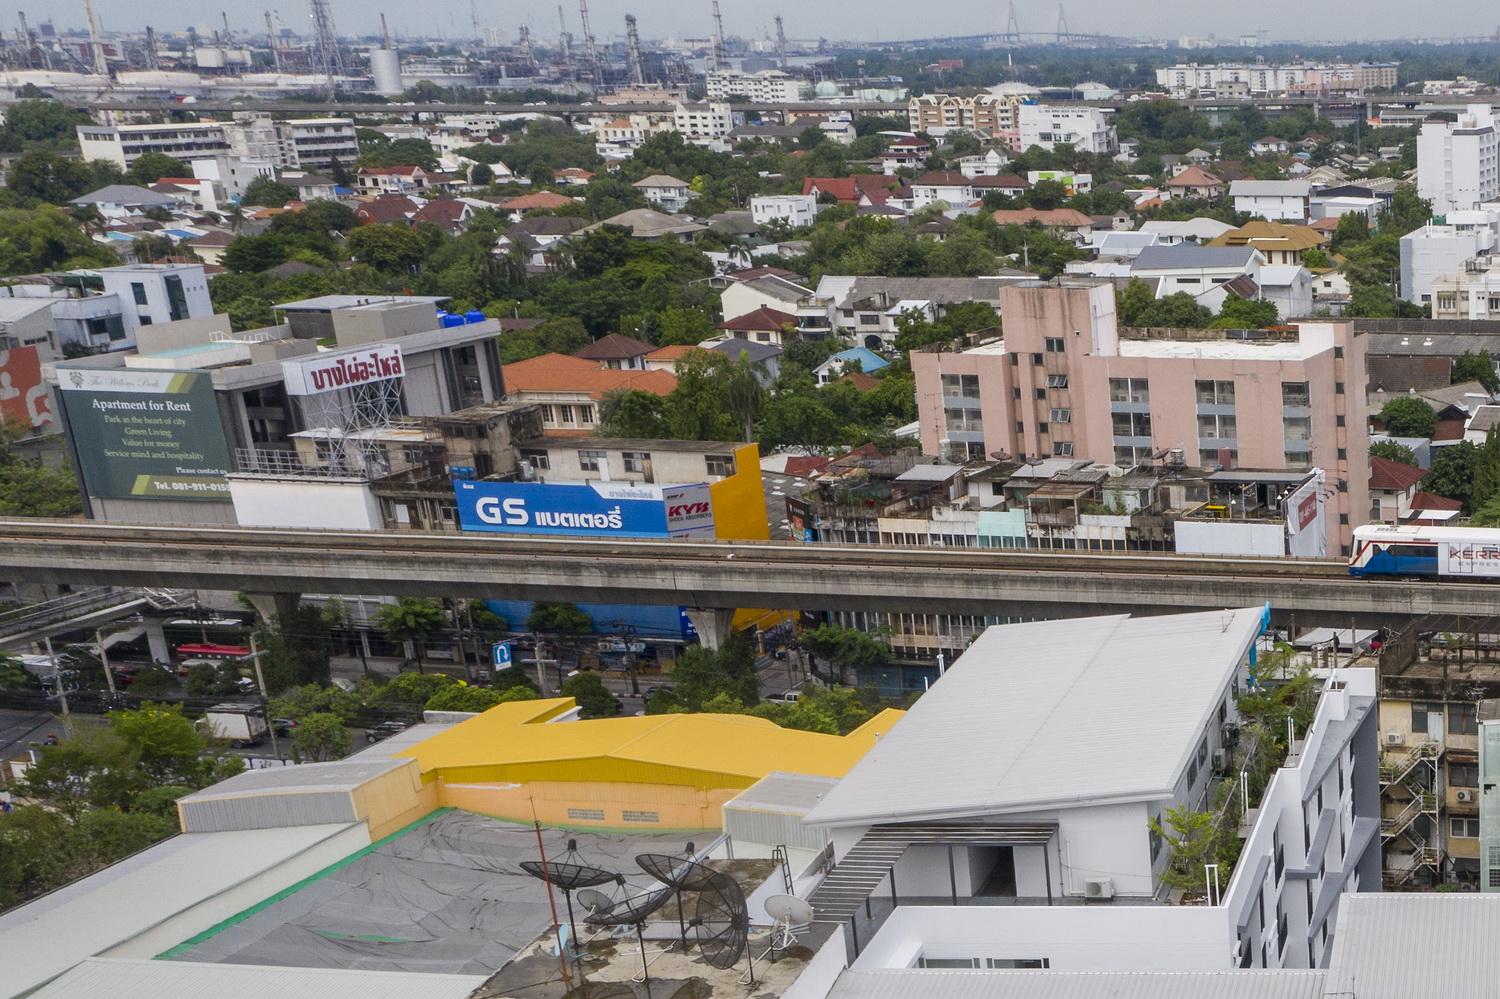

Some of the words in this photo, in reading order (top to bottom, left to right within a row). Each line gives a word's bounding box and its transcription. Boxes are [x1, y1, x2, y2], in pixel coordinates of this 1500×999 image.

[92, 398, 147, 412] Apartment
[149, 400, 164, 411] for
[165, 400, 191, 412] Rent
[104, 415, 121, 423] Park
[131, 416, 143, 424] the
[144, 416, 163, 425] heart
[164, 417, 172, 425] of
[173, 417, 186, 427] city
[124, 427, 147, 435] Green
[148, 427, 173, 438] Living
[121, 438, 142, 447] Value
[144, 439, 155, 447] for
[155, 441, 180, 449] money
[104, 449, 129, 457] Service
[130, 450, 150, 458] mind
[166, 451, 204, 461] hospitality
[475, 496, 529, 526] GS
[535, 505, 623, 529] แบตเตอรี่
[668, 501, 710, 518] KYB
